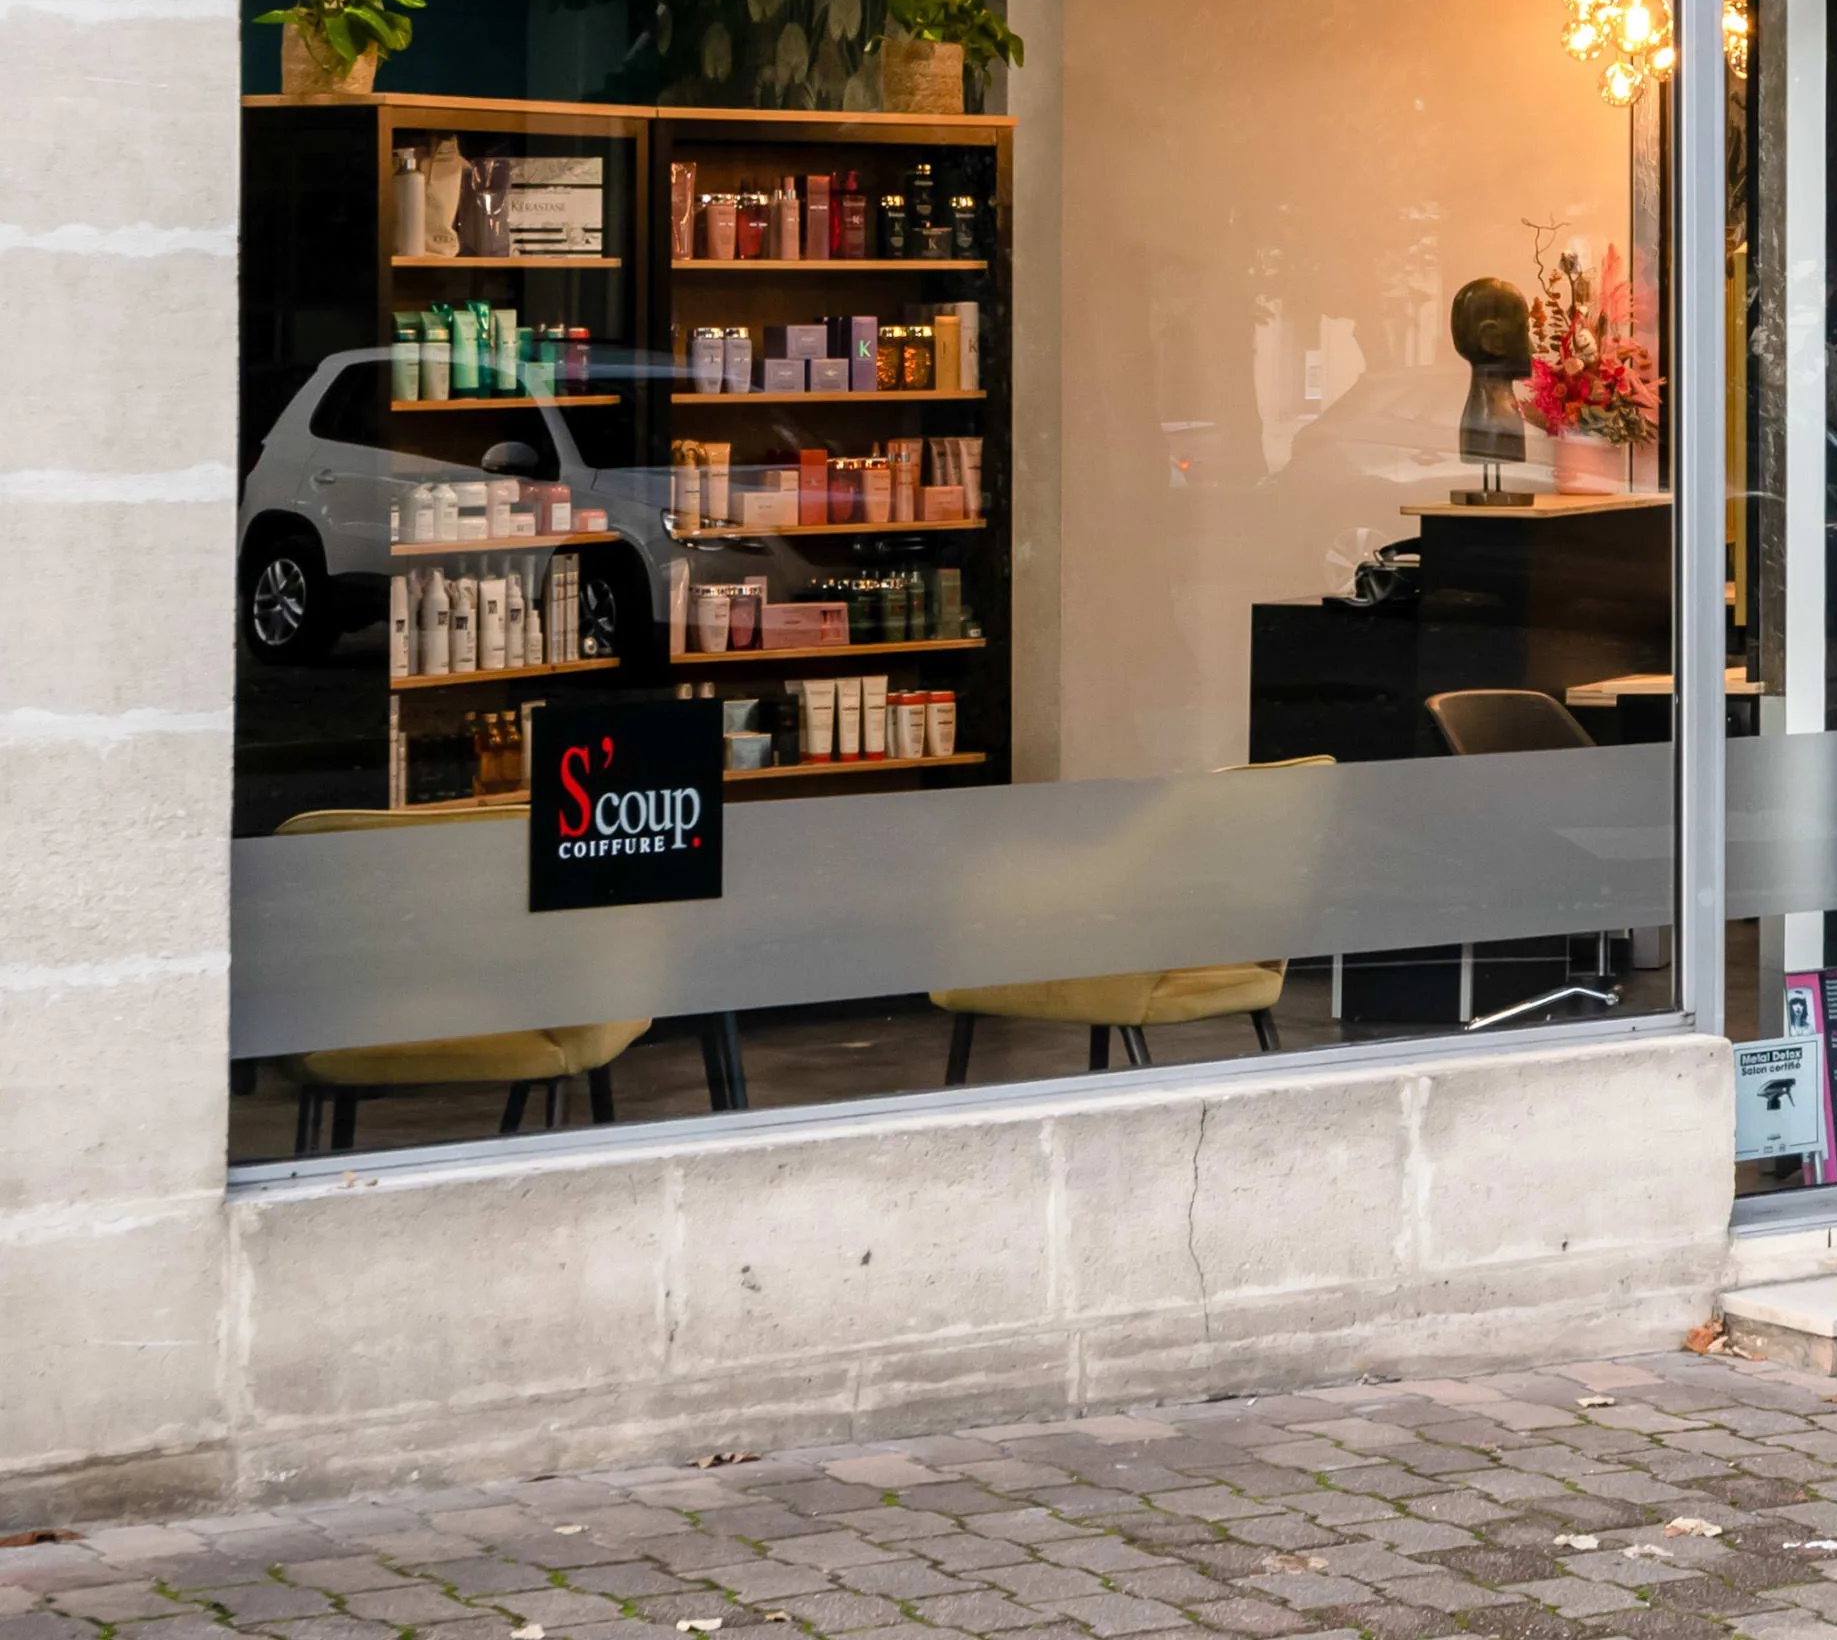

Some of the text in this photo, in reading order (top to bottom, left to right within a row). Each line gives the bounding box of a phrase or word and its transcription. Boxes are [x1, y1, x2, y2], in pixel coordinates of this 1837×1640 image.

[558, 835, 666, 859] COIFFURE
[1742, 1049, 1801, 1066] Metal Detox
[1741, 1065, 1767, 1077] Salon
